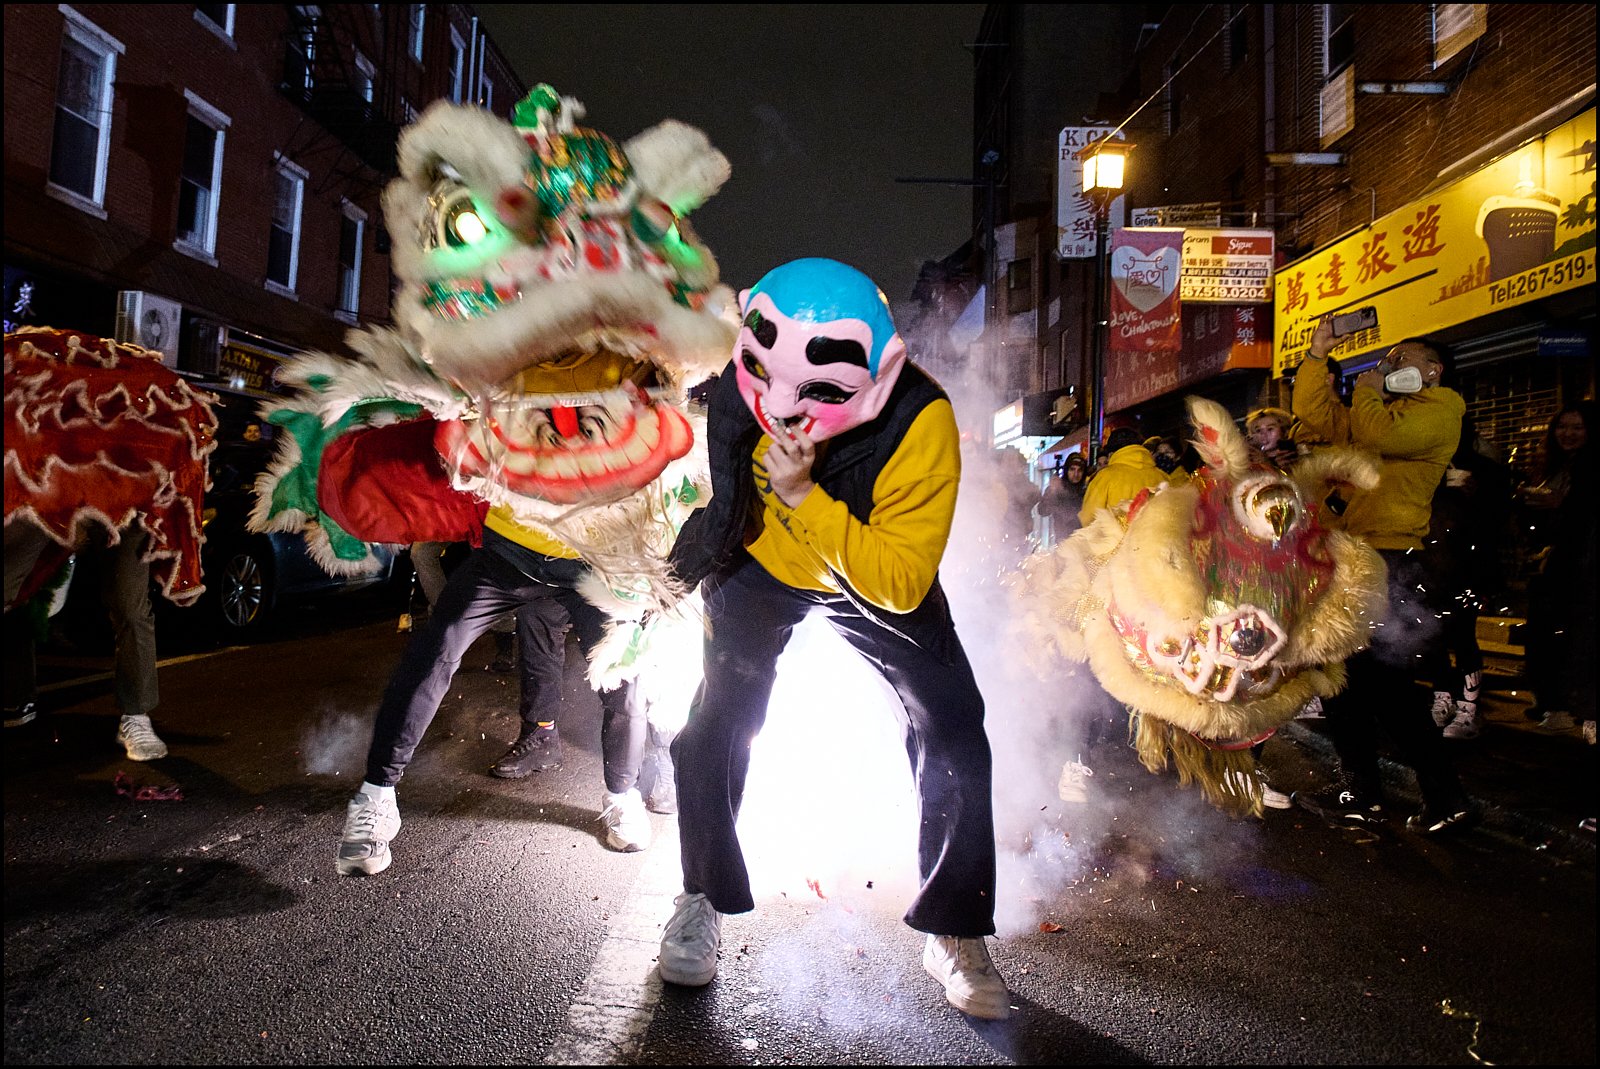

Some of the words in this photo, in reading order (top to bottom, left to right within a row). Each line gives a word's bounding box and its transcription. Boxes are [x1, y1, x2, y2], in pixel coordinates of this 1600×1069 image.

[1134, 214, 1168, 226] Gregoy
[1282, 204, 1447, 315] 萬達旅遊
[1489, 256, 1594, 306] Tel:267-519-
